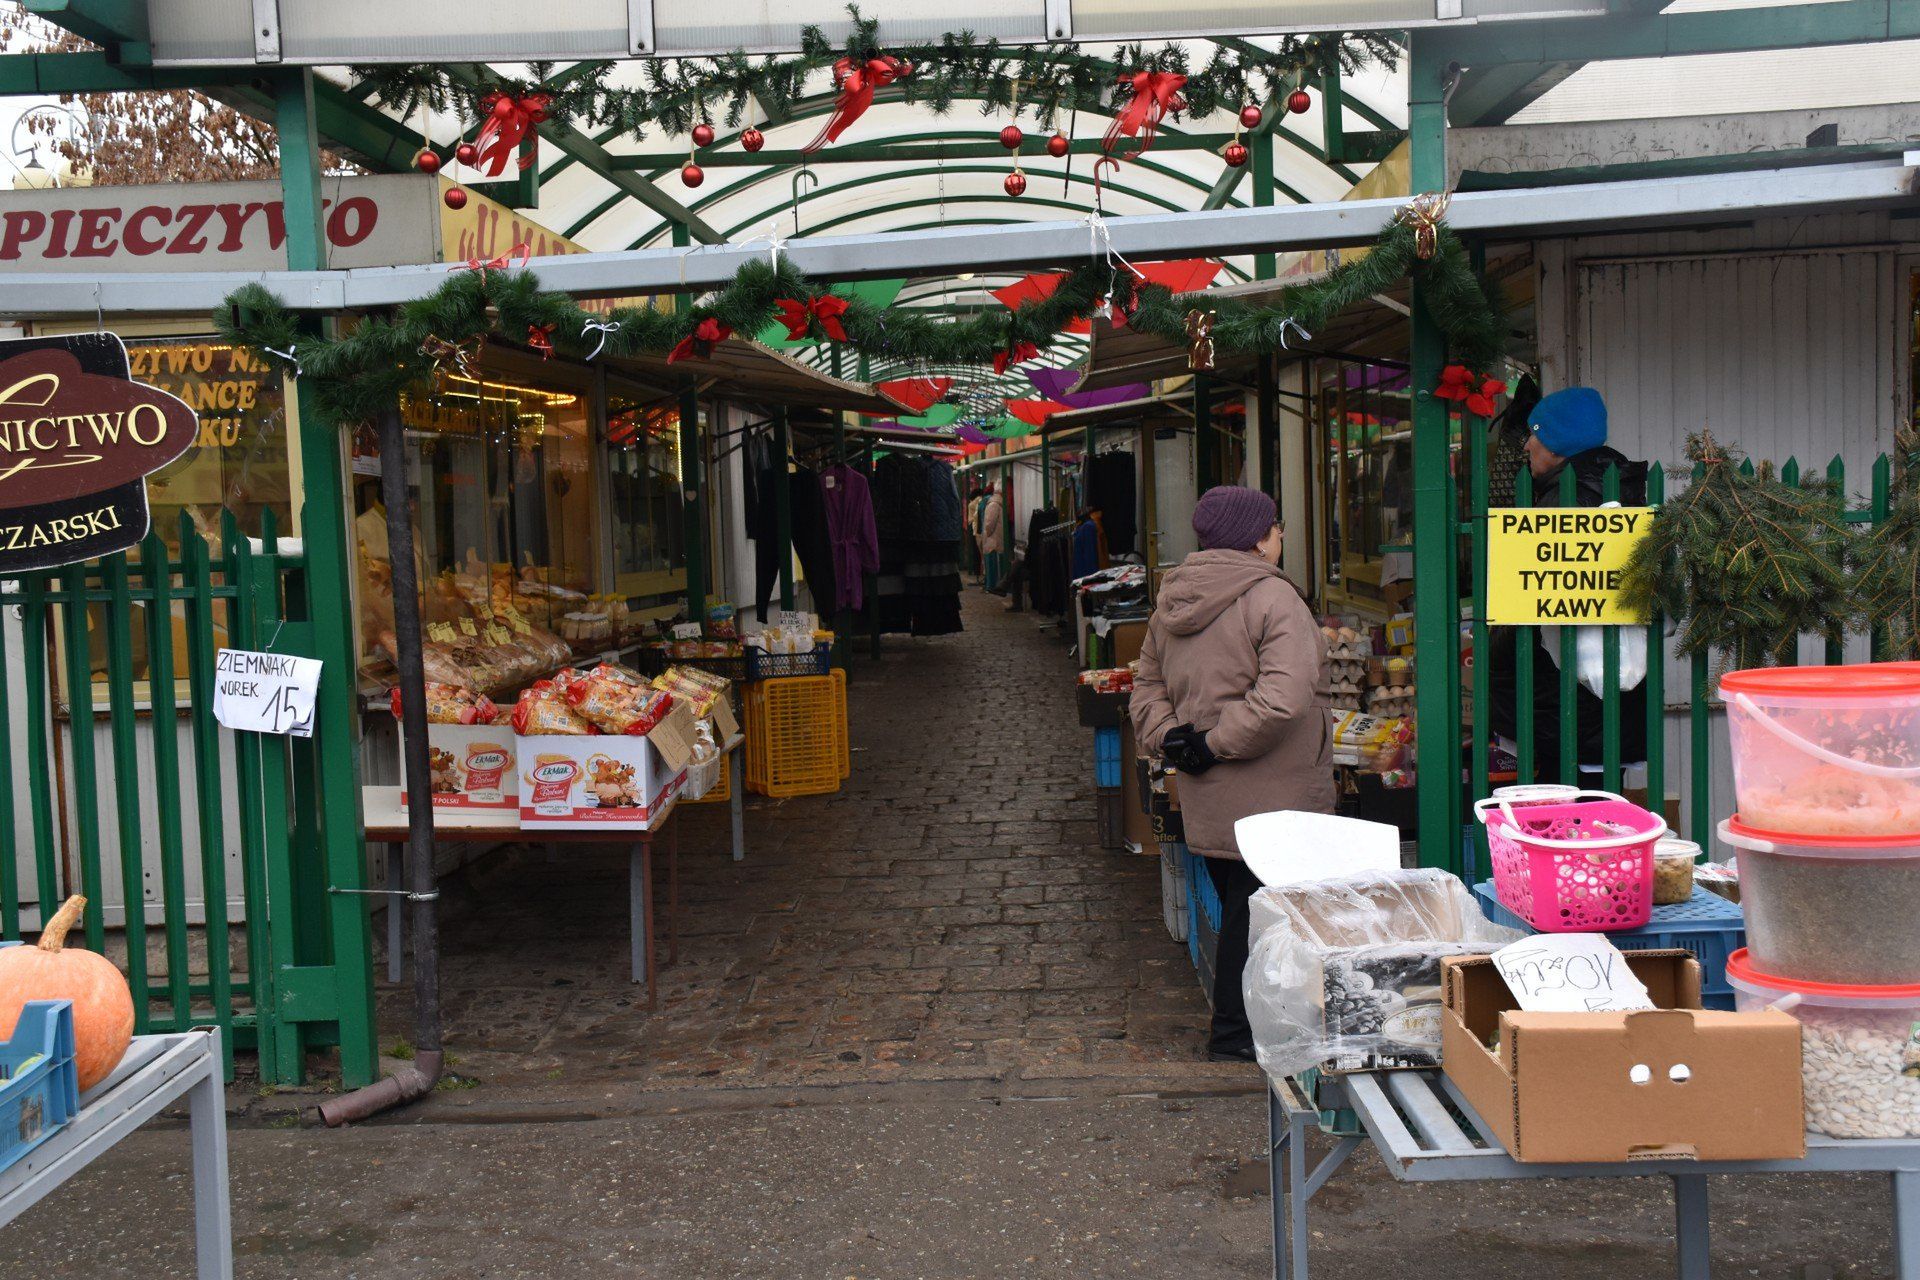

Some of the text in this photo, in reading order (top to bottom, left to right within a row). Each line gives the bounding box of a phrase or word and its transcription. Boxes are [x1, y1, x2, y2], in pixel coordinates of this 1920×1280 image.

[0, 505, 122, 551] ZARSKI
[1502, 513, 1639, 534] PAPIEROSY
[1536, 542, 1604, 563] GILZY
[1518, 570, 1621, 591] TYTONIE
[1536, 598, 1607, 618] KAWY
